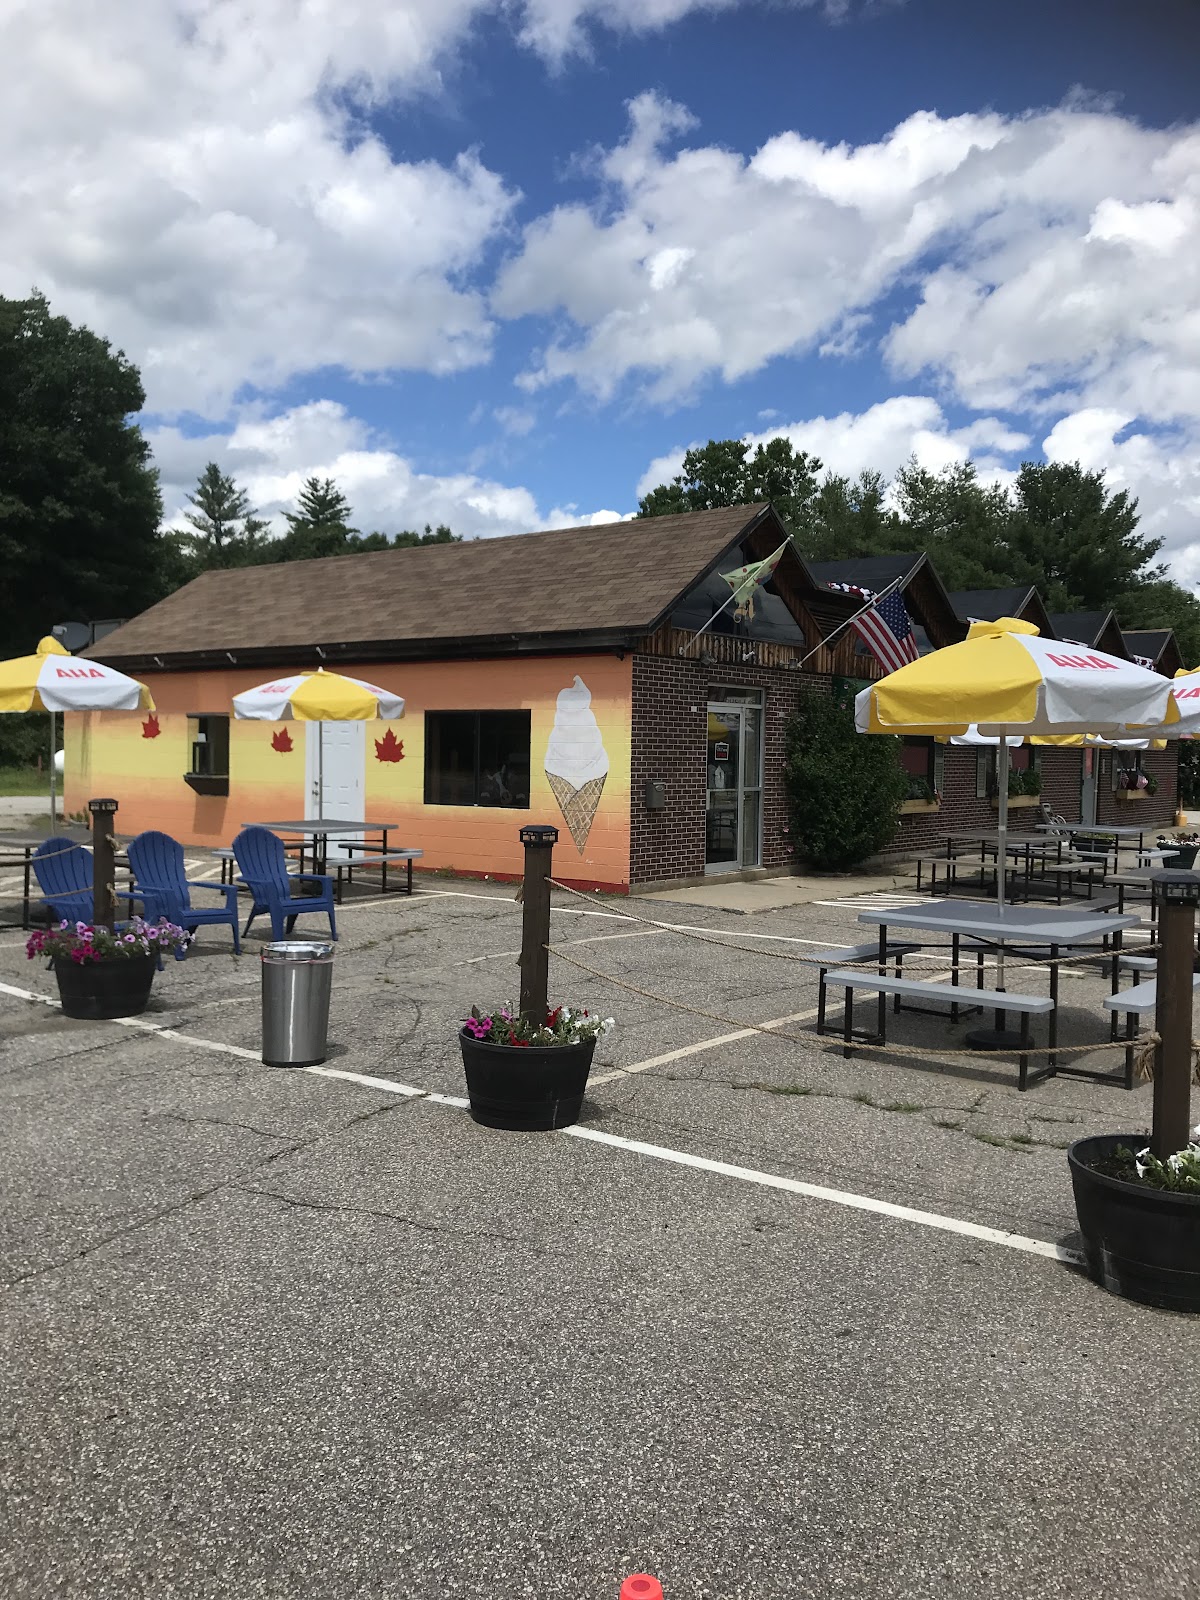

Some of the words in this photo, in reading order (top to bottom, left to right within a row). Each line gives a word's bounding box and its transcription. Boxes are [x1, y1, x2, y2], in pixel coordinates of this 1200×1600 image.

[1045, 653, 1121, 669] AHA
[56, 668, 106, 678] AHA
[1171, 687, 1200, 699] HA
